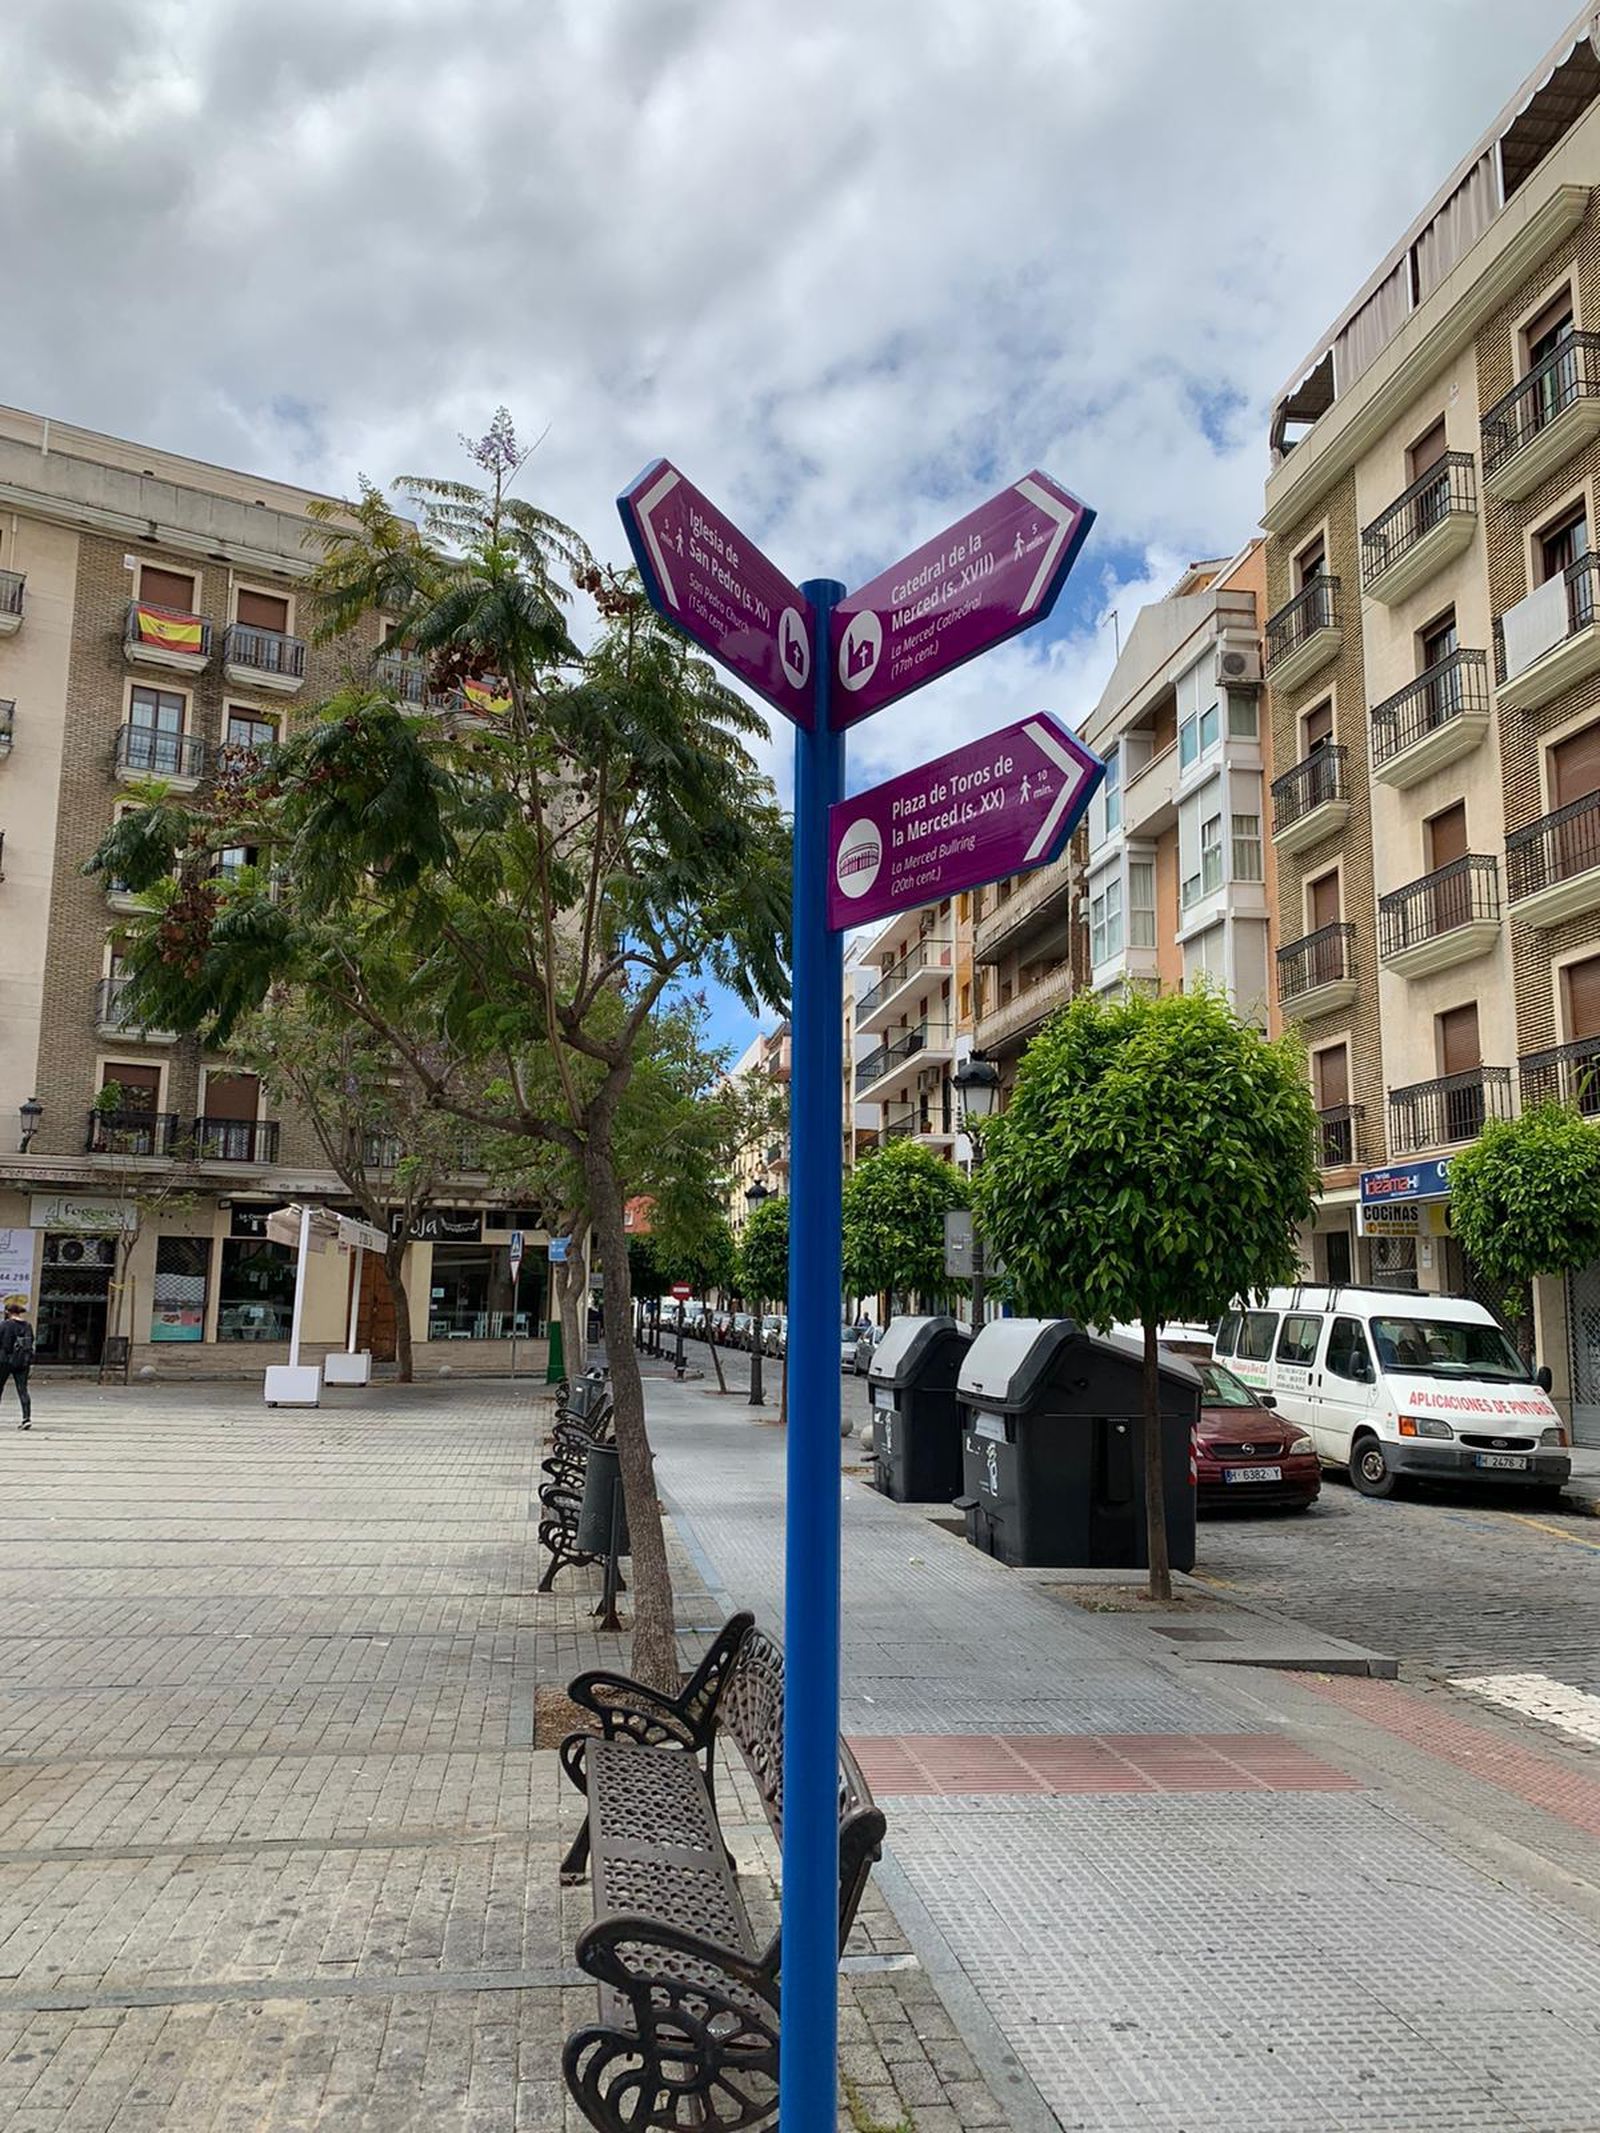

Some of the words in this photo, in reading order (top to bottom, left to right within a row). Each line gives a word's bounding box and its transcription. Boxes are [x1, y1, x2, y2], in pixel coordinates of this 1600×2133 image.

[690, 507, 724, 554] Iglesia
[726, 544, 738, 569] de
[1032, 523, 1038, 535] 5
[689, 538, 709, 571] San
[712, 557, 741, 599] Pedro
[743, 587, 753, 612] (s.
[755, 598, 771, 629] XV)
[892, 554, 945, 604] Catedral
[949, 545, 965, 567] de
[969, 534, 982, 555] la
[892, 588, 943, 632] Merced
[942, 581, 957, 603] (s.
[961, 552, 994, 590] XVII)
[688, 573, 703, 594] San
[704, 586, 724, 613] Pedro
[726, 606, 749, 635] Church
[688, 594, 708, 621] (15th
[891, 645, 902, 660] La
[903, 622, 935, 651] Merced
[936, 593, 982, 632] Cathedral
[891, 656, 913, 680] (17th
[892, 796, 926, 821] Plaza
[930, 783, 947, 805] de
[950, 766, 990, 796] Toros
[994, 755, 1013, 778] de
[1037, 769, 1048, 781] 10
[892, 828, 904, 848] la
[907, 803, 957, 841] Merced
[961, 802, 977, 824] (s.
[980, 787, 1005, 814] XX)
[891, 861, 901, 875] La
[904, 846, 937, 870] Merced
[939, 834, 975, 859] Bullring
[891, 875, 915, 896] (20th
[1410, 1391, 1493, 1413] APLICACIONES
[1491, 1400, 1510, 1414] DE
